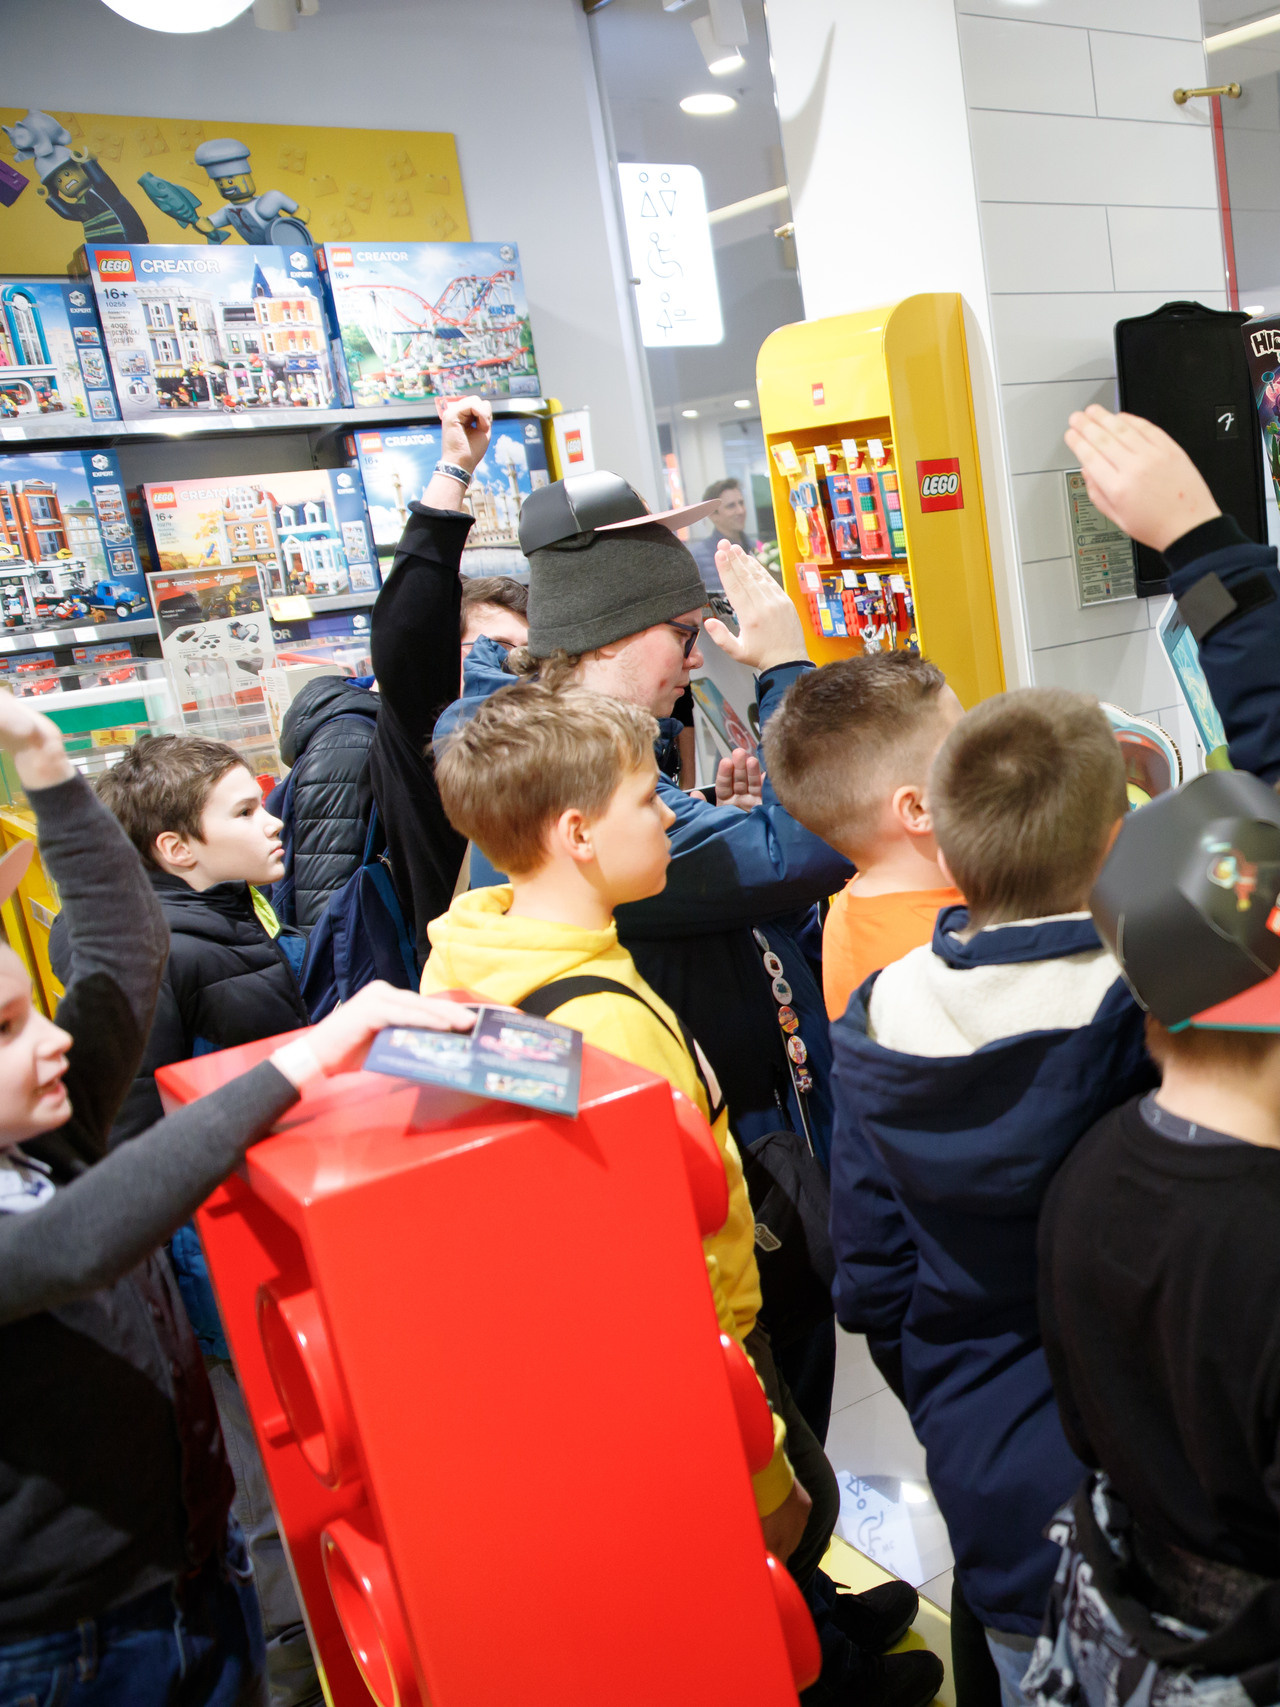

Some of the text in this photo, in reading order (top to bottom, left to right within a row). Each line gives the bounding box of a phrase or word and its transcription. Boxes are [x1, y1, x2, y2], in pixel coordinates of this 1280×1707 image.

[357, 251, 409, 262] CREATOR
[99, 258, 220, 274] LEGO CREATOR
[103, 288, 128, 299] 16+
[384, 434, 434, 447] CREATOR
[922, 473, 959, 496] LEGO
[153, 487, 238, 503] LEGO CREATOR
[155, 512, 174, 521] 16+
